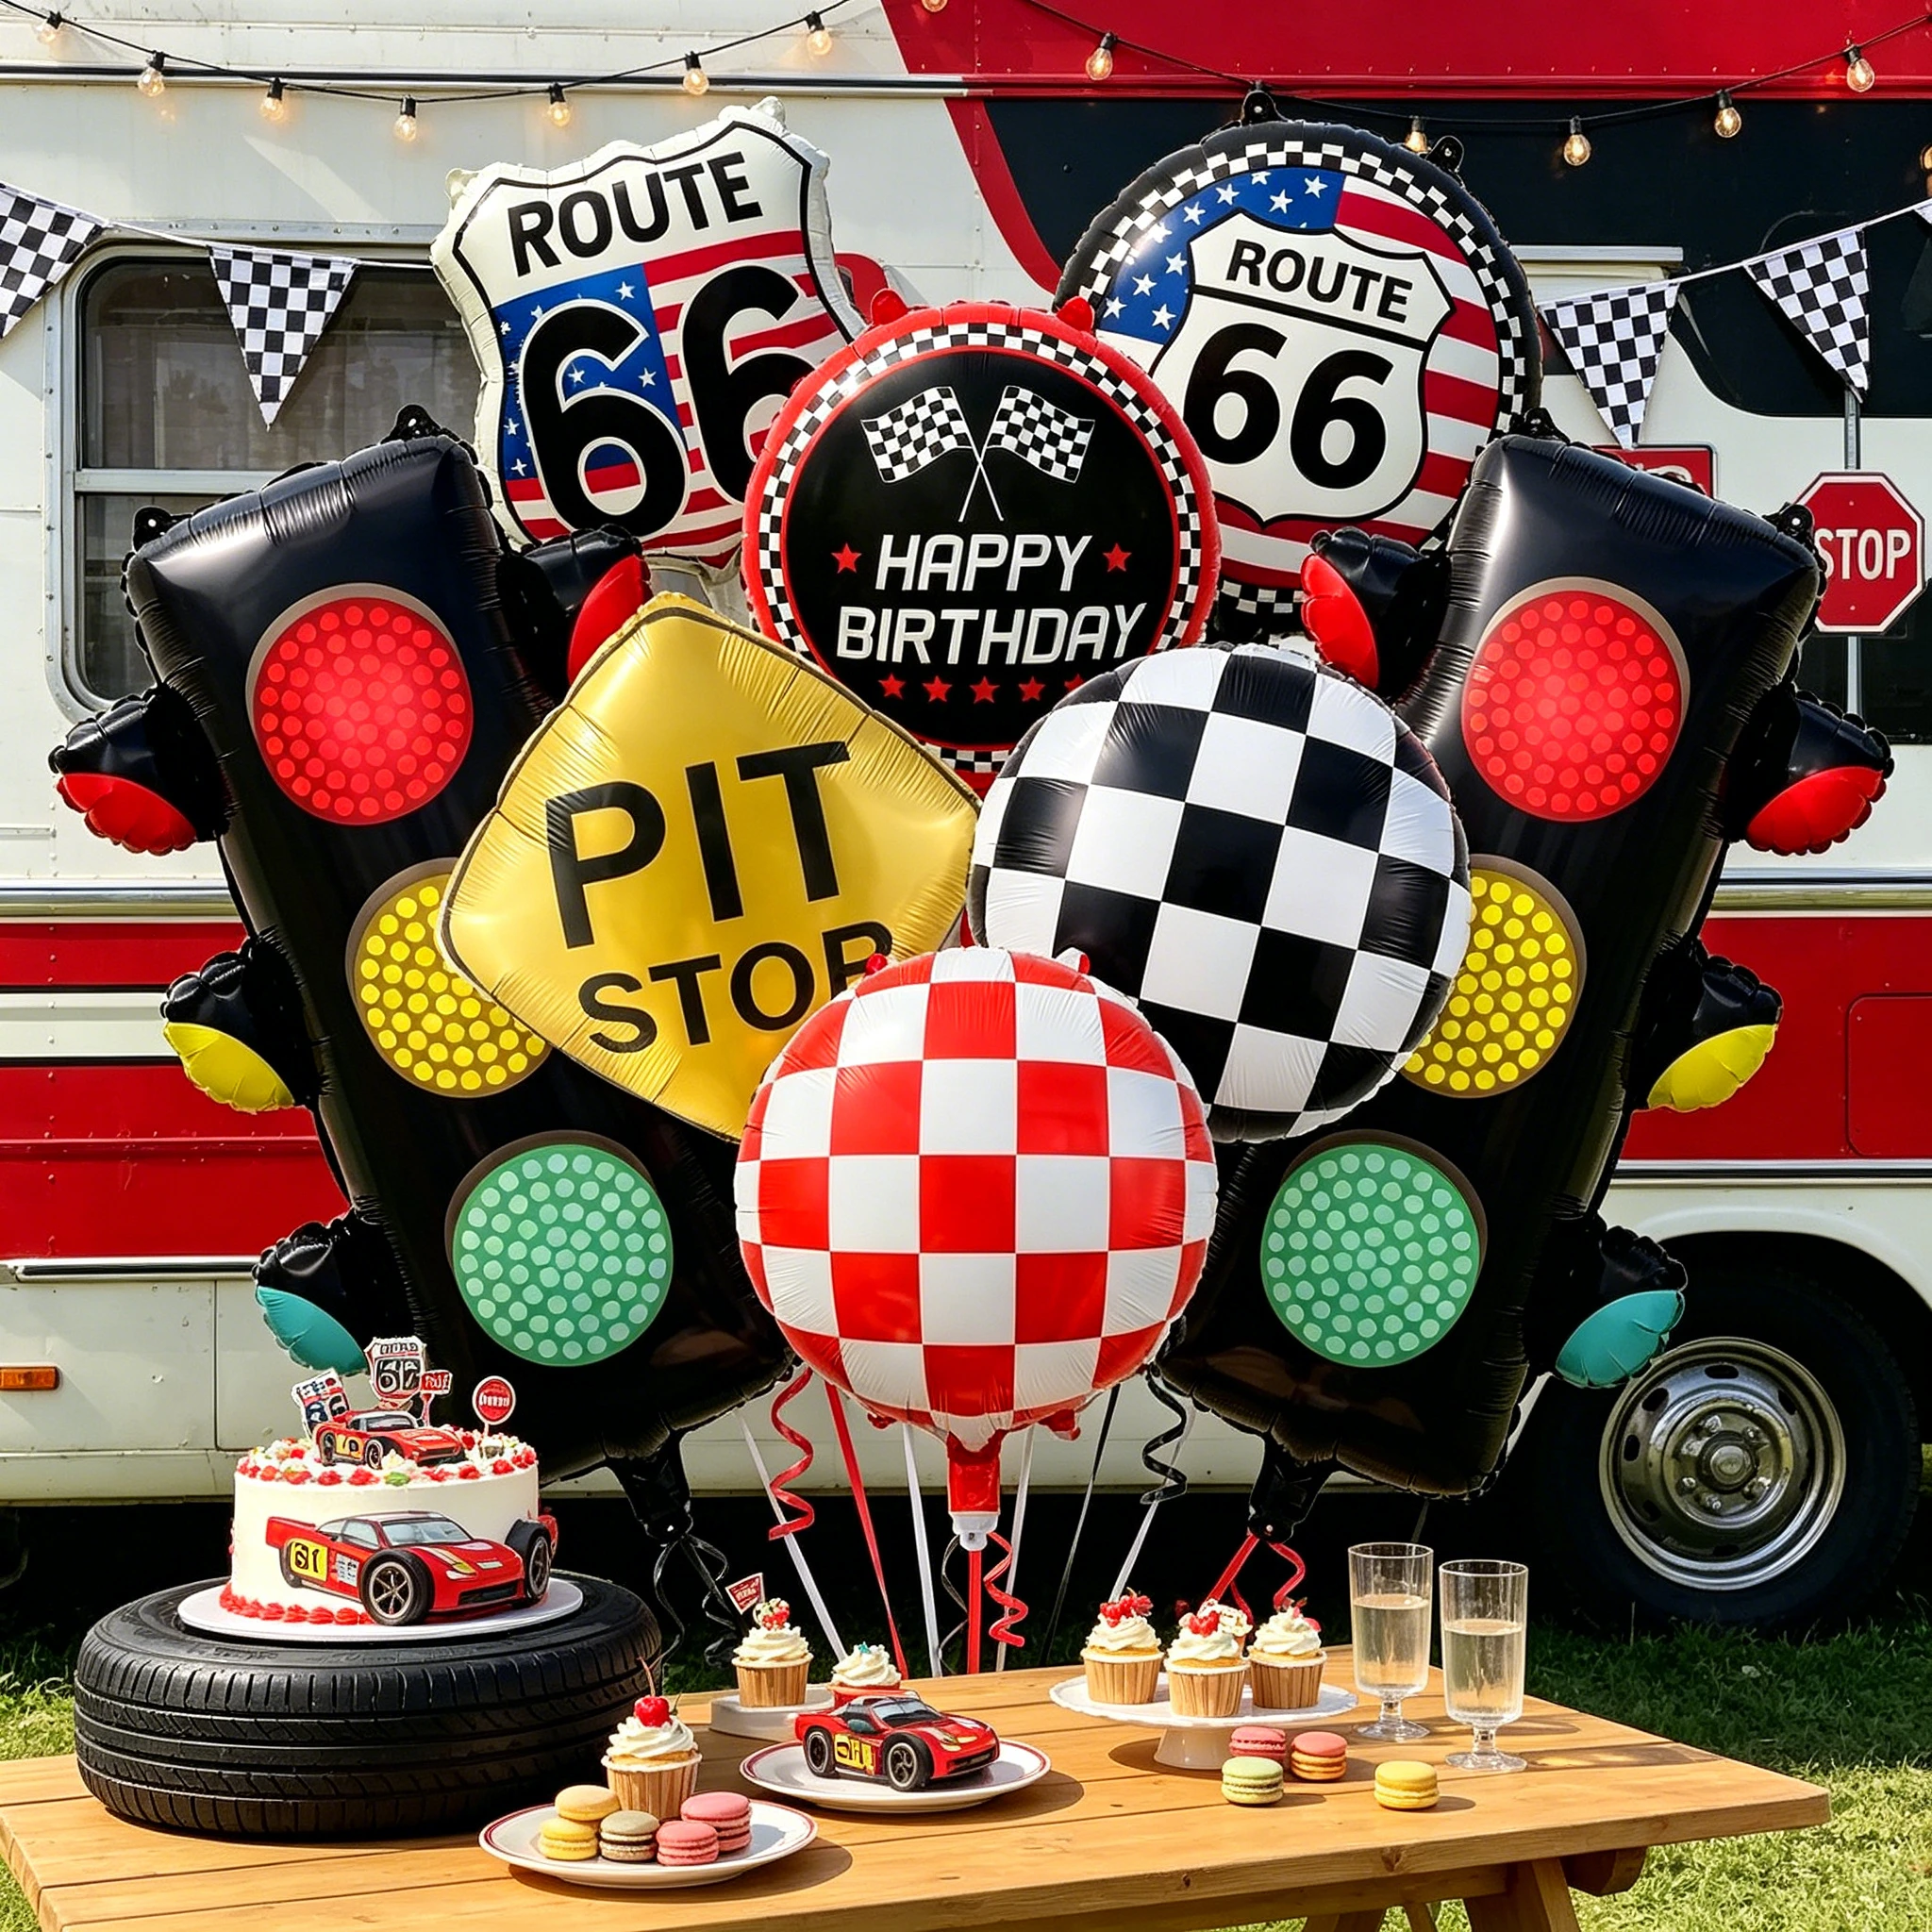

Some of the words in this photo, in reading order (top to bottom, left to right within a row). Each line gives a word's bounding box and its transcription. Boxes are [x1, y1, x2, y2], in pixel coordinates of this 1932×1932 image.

[507, 151, 763, 277] ROUTE
[1225, 239, 1413, 325] ROUTE
[523, 264, 817, 535] 66
[1183, 322, 1394, 490] 66
[874, 533, 1093, 591] HAPPY
[1813, 528, 1911, 580] STOP
[836, 602, 1148, 665] BIRTHDAY
[544, 741, 852, 950] PIT
[577, 921, 893, 1054] STOP
